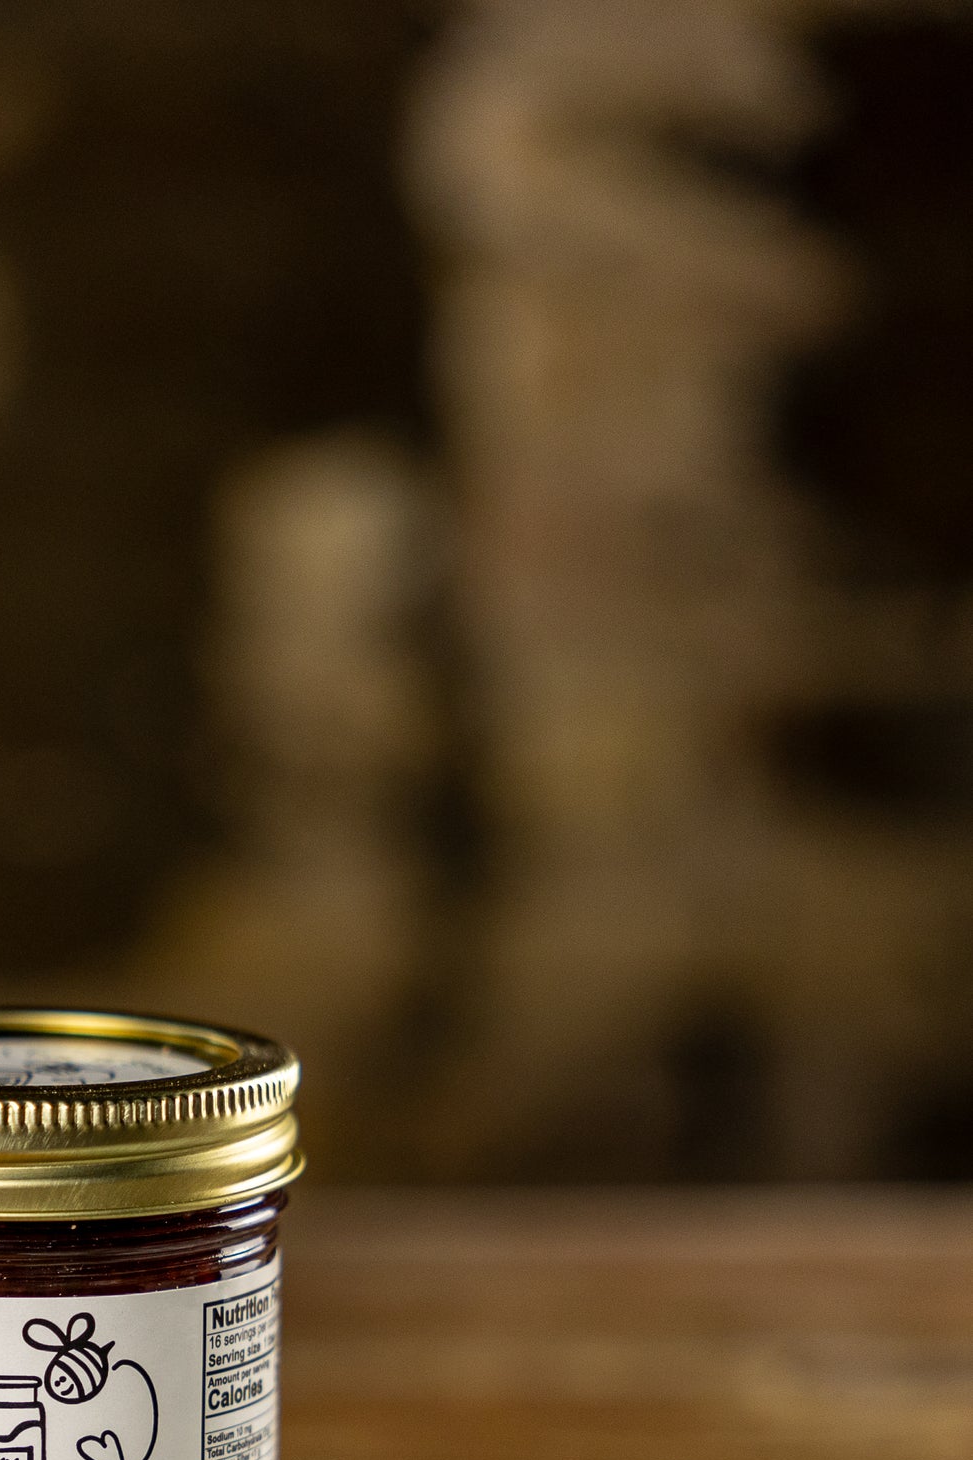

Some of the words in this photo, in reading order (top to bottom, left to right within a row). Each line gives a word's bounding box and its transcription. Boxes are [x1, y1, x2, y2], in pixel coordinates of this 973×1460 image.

[212, 1295, 269, 1329] Nutrition
[209, 1335, 221, 1349] 16
[224, 1325, 256, 1347] servings
[208, 1347, 245, 1368] Serving
[246, 1342, 261, 1356] size
[207, 1372, 240, 1388] Amount
[241, 1366, 251, 1382] per
[208, 1378, 263, 1410] Calories
[207, 1430, 234, 1445] Sodium
[207, 1447, 225, 1459] Total
